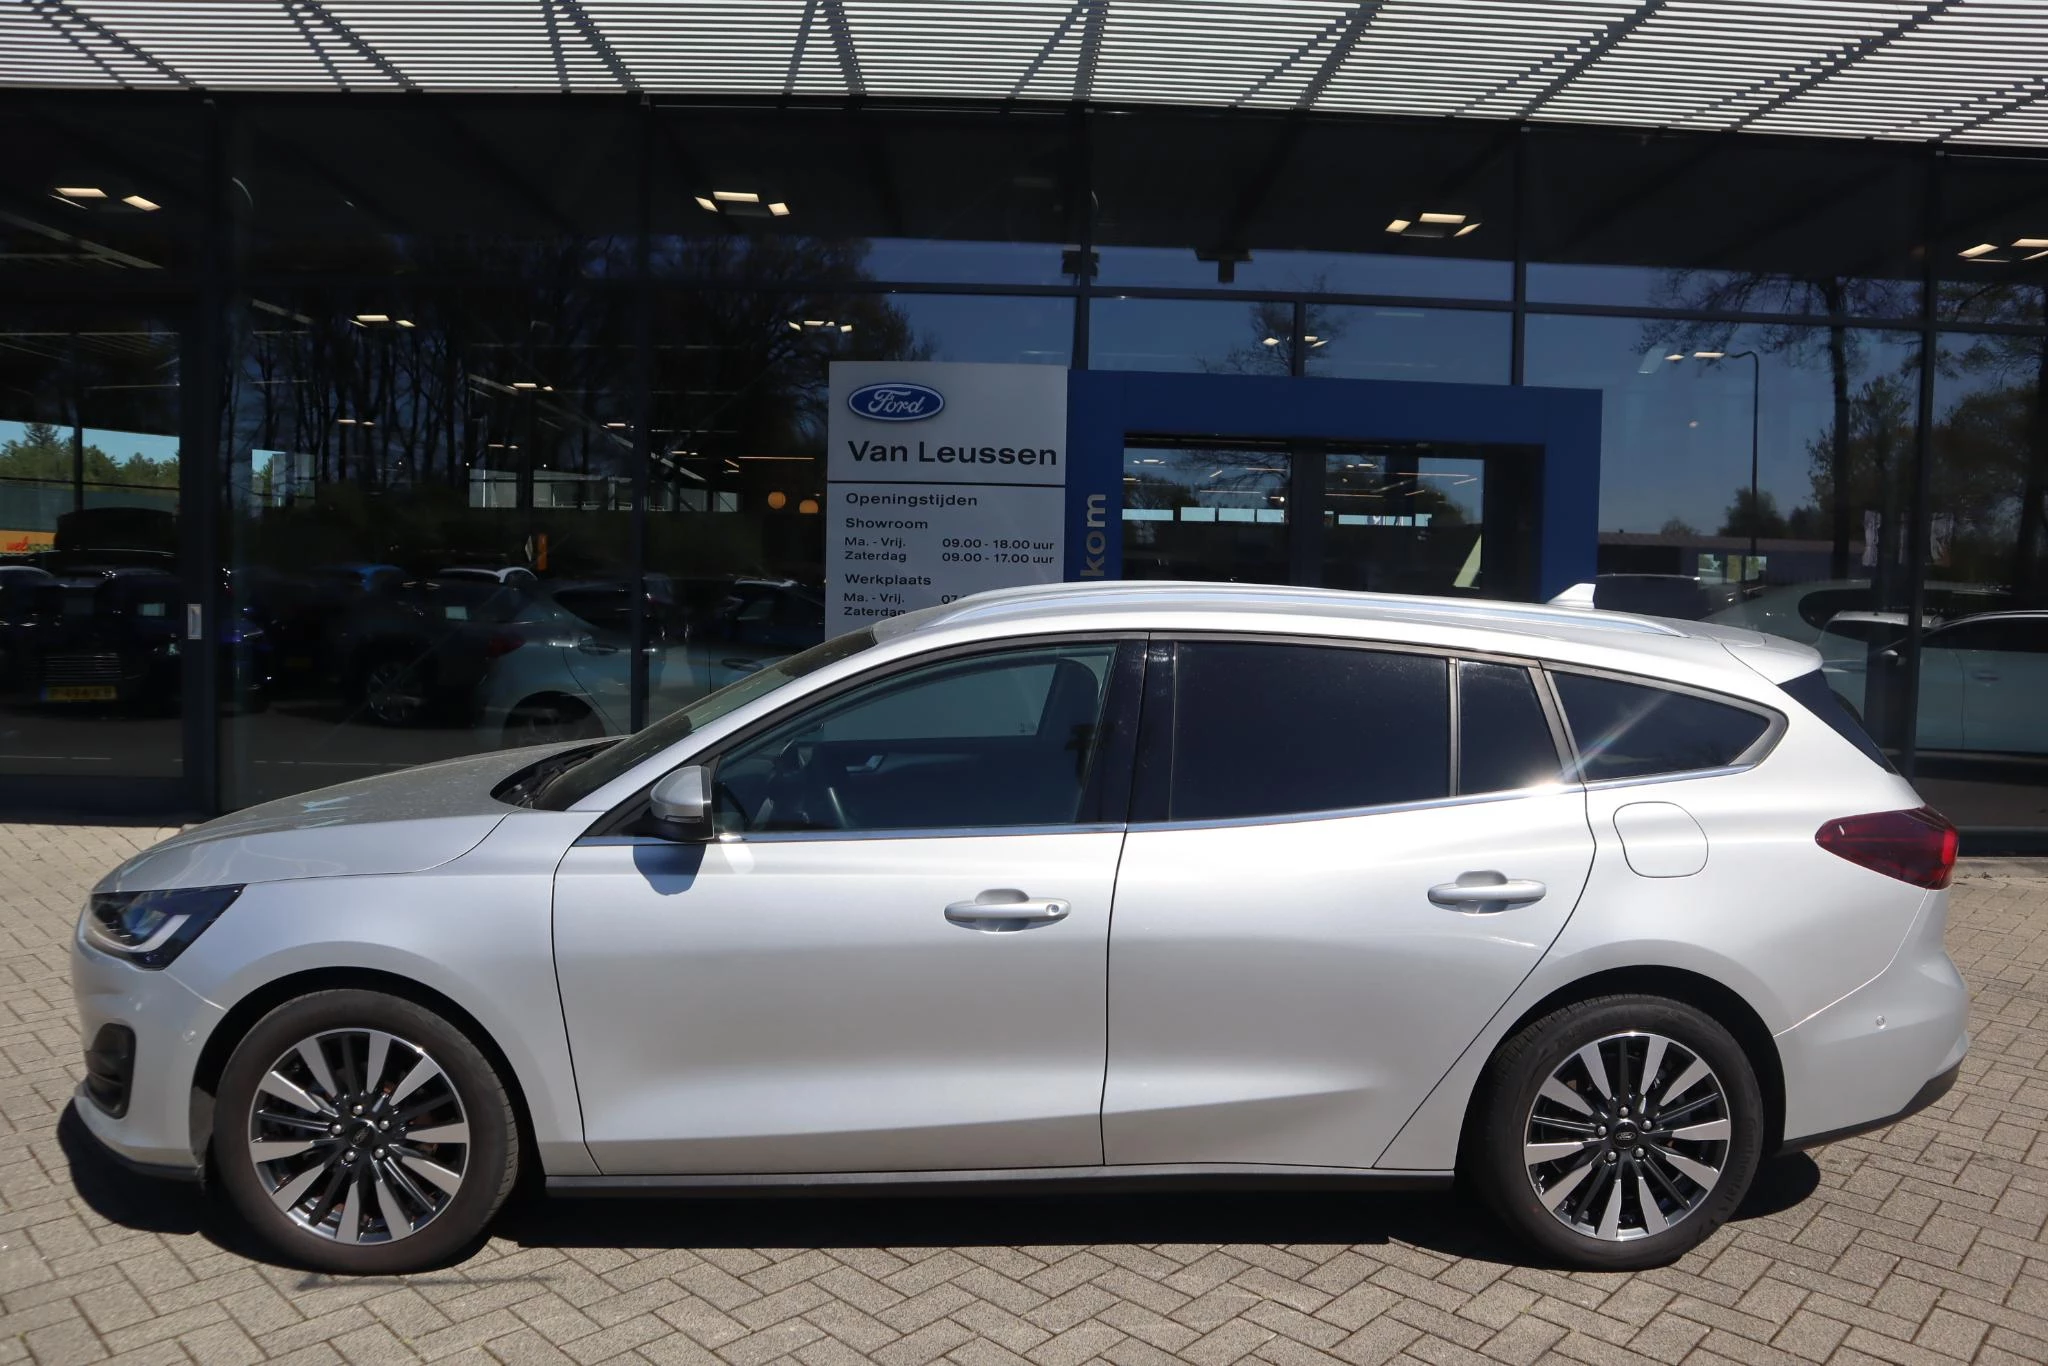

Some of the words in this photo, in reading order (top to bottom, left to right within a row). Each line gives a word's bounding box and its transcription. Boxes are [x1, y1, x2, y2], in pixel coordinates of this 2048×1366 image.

[867, 389, 926, 413] Ford
[847, 440, 908, 462] Van
[918, 441, 1057, 466] Leussen
[845, 492, 978, 508] Openingstijden
[845, 517, 929, 529] Showroom
[844, 537, 869, 547] Ma.
[880, 537, 906, 549] Vrij.
[942, 538, 982, 548] 09.00
[993, 539, 1030, 549] 18.00
[1033, 541, 1054, 550] uur
[844, 551, 907, 563] Zaterdag
[942, 552, 982, 562] 09.00
[994, 553, 1030, 563] 17.00
[1032, 555, 1054, 564] uur
[845, 573, 932, 586] Werkplaats
[843, 592, 869, 602] Ma.
[880, 592, 905, 604] Vrij.
